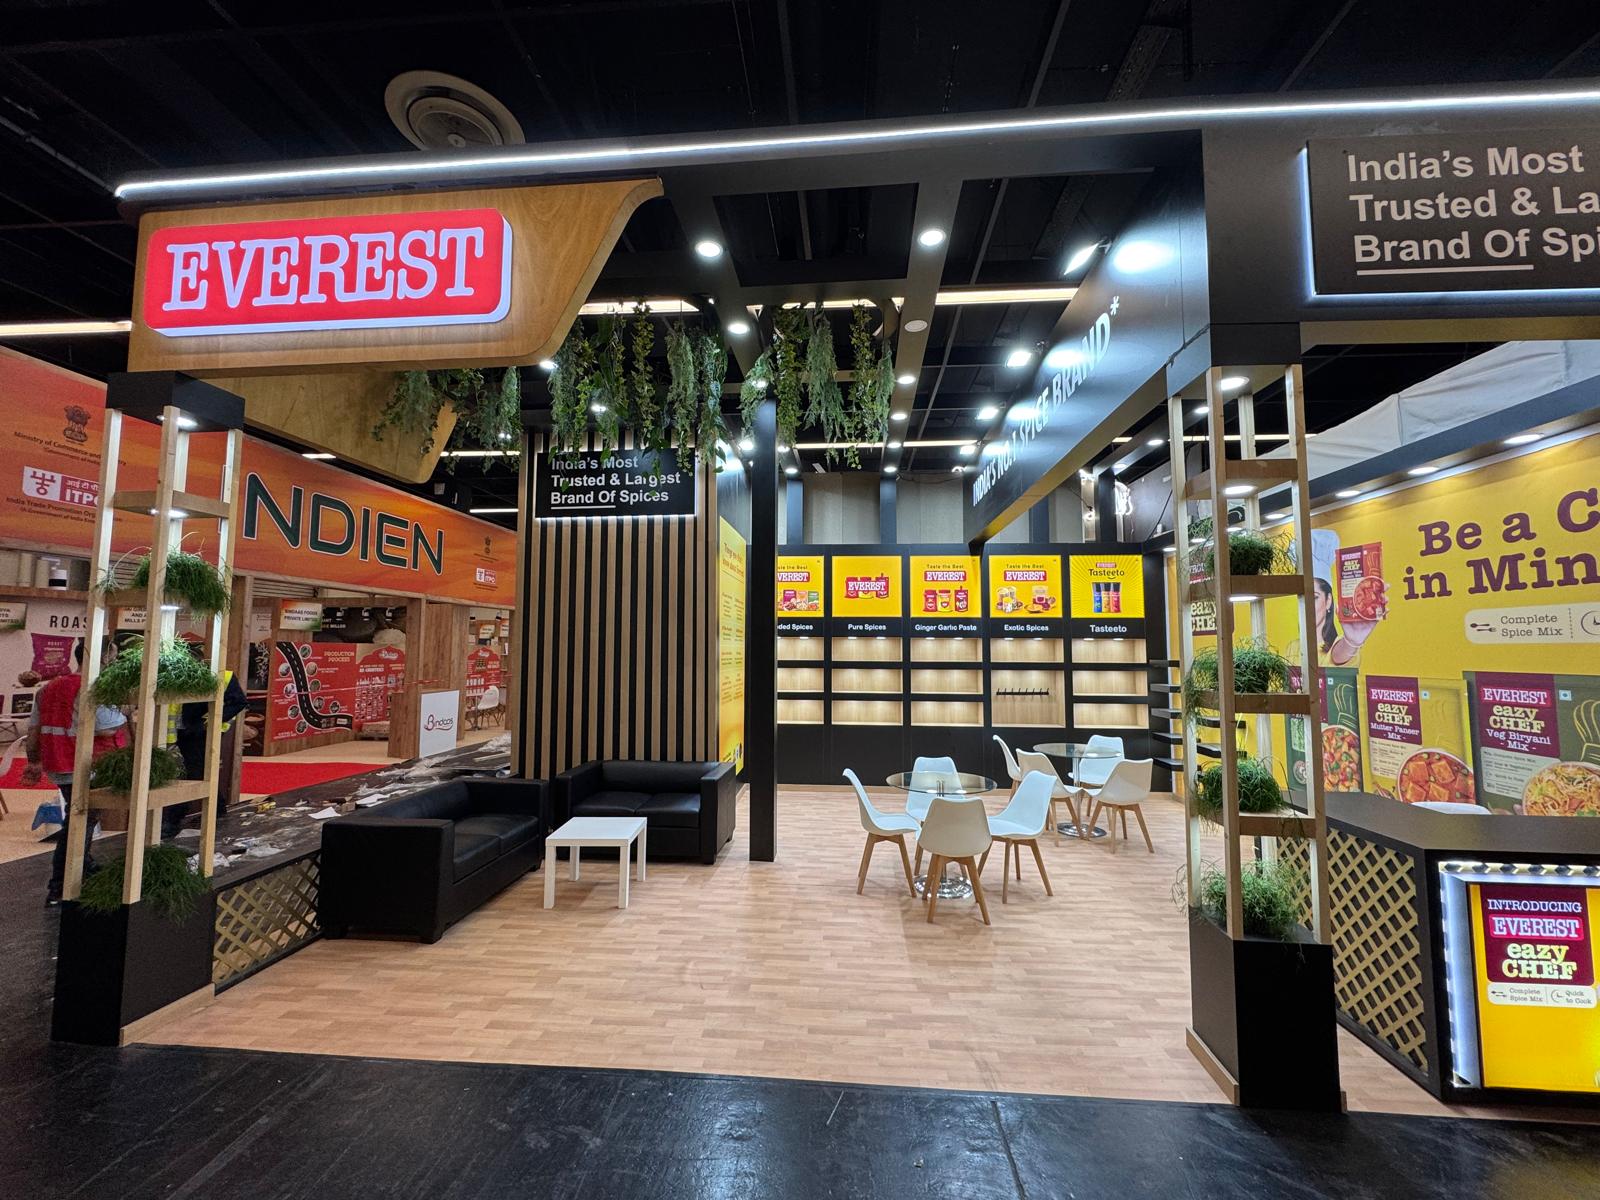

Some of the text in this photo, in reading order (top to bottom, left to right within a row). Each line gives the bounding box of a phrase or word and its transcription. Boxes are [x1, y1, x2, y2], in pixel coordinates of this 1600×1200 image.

[1348, 145, 1585, 182] India's Most
[1349, 188, 1497, 222] Trusted
[1511, 187, 1540, 215] &
[1354, 231, 1471, 263] Brand
[1484, 228, 1530, 258] Of
[162, 226, 485, 311] EVEREST
[552, 456, 638, 470] India's Most
[551, 471, 681, 488] Trusted & Largest
[551, 489, 669, 505] Brand Of Spices
[220, 465, 444, 576] NDIEN
[1418, 521, 1482, 557] Be
[1502, 512, 1537, 543] a
[777, 572, 809, 582] VEREST
[925, 571, 966, 581] EVEREST
[1005, 571, 1046, 581] EVEREST
[1088, 568, 1125, 577] Tasteeto
[847, 580, 887, 591] EVEREST
[1403, 566, 1453, 600] in
[1501, 613, 1558, 627] Complete
[792, 624, 813, 632] Spices
[867, 624, 887, 632] Spices
[915, 624, 938, 632] Ginger
[1026, 624, 1049, 632] Spices
[1089, 625, 1128, 633] Tasteeto
[1501, 625, 1563, 639] Spice Mix
[1371, 689, 1414, 702] EVEREST
[1482, 688, 1547, 704] EVEREST
[1377, 703, 1408, 715] eazy
[1492, 704, 1539, 720] eazy
[1375, 711, 1412, 726] CHEF
[1488, 715, 1545, 733] CHEF
[1370, 722, 1419, 736] Mutter Paneer
[1387, 732, 1402, 740] Mix
[1485, 728, 1552, 745] Veg Biryani
[1507, 740, 1530, 751] Mix
[1487, 899, 1582, 913] INTRODUCING
[1492, 916, 1580, 938] EVEREST
[1506, 942, 1570, 964] eazy
[1501, 959, 1577, 980] CHEF
[1509, 987, 1585, 998] Complete Quick
[1509, 995, 1528, 1003] Spice
[1575, 997, 1592, 1005] Cook
